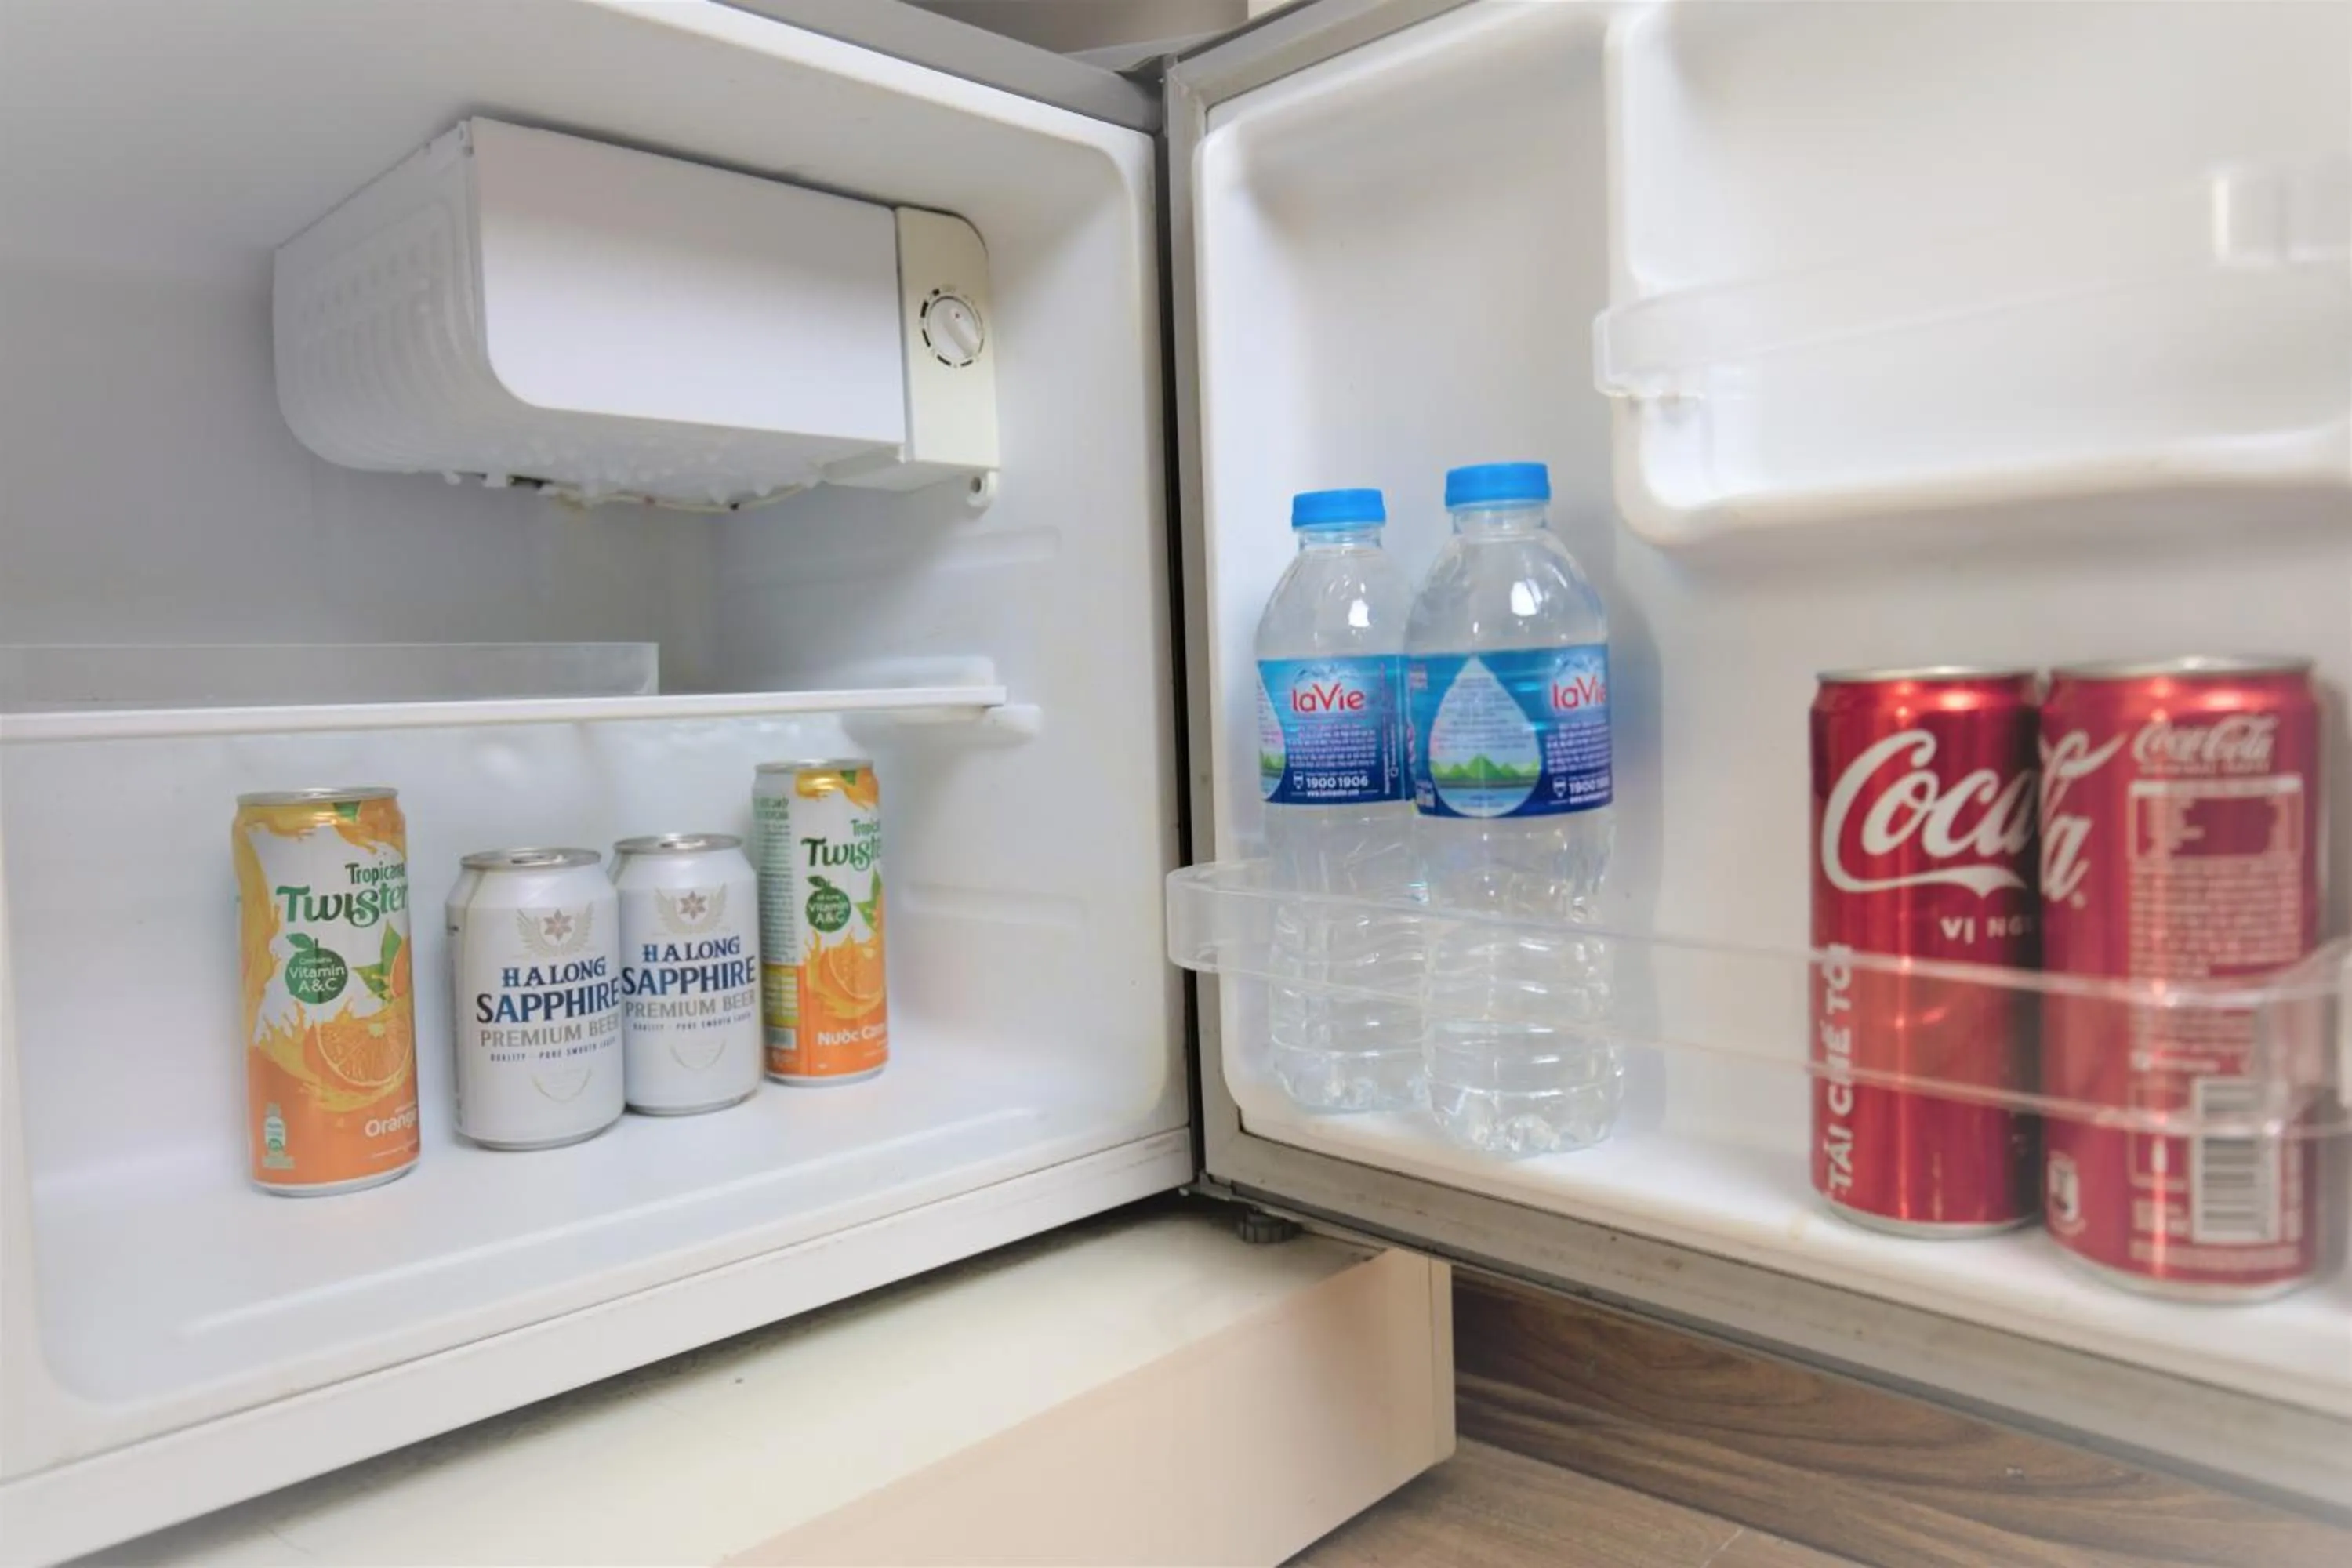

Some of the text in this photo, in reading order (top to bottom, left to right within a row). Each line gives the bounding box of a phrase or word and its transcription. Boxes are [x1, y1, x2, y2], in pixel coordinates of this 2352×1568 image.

[289, 964, 345, 979] Vitamin
[621, 955, 756, 996] SAPPHIRE
[477, 977, 619, 1024] SAPPHIRE
[626, 998, 717, 1018] PREMIUM
[481, 1024, 582, 1048] PREMIUM
[365, 1110, 416, 1137] Orang
